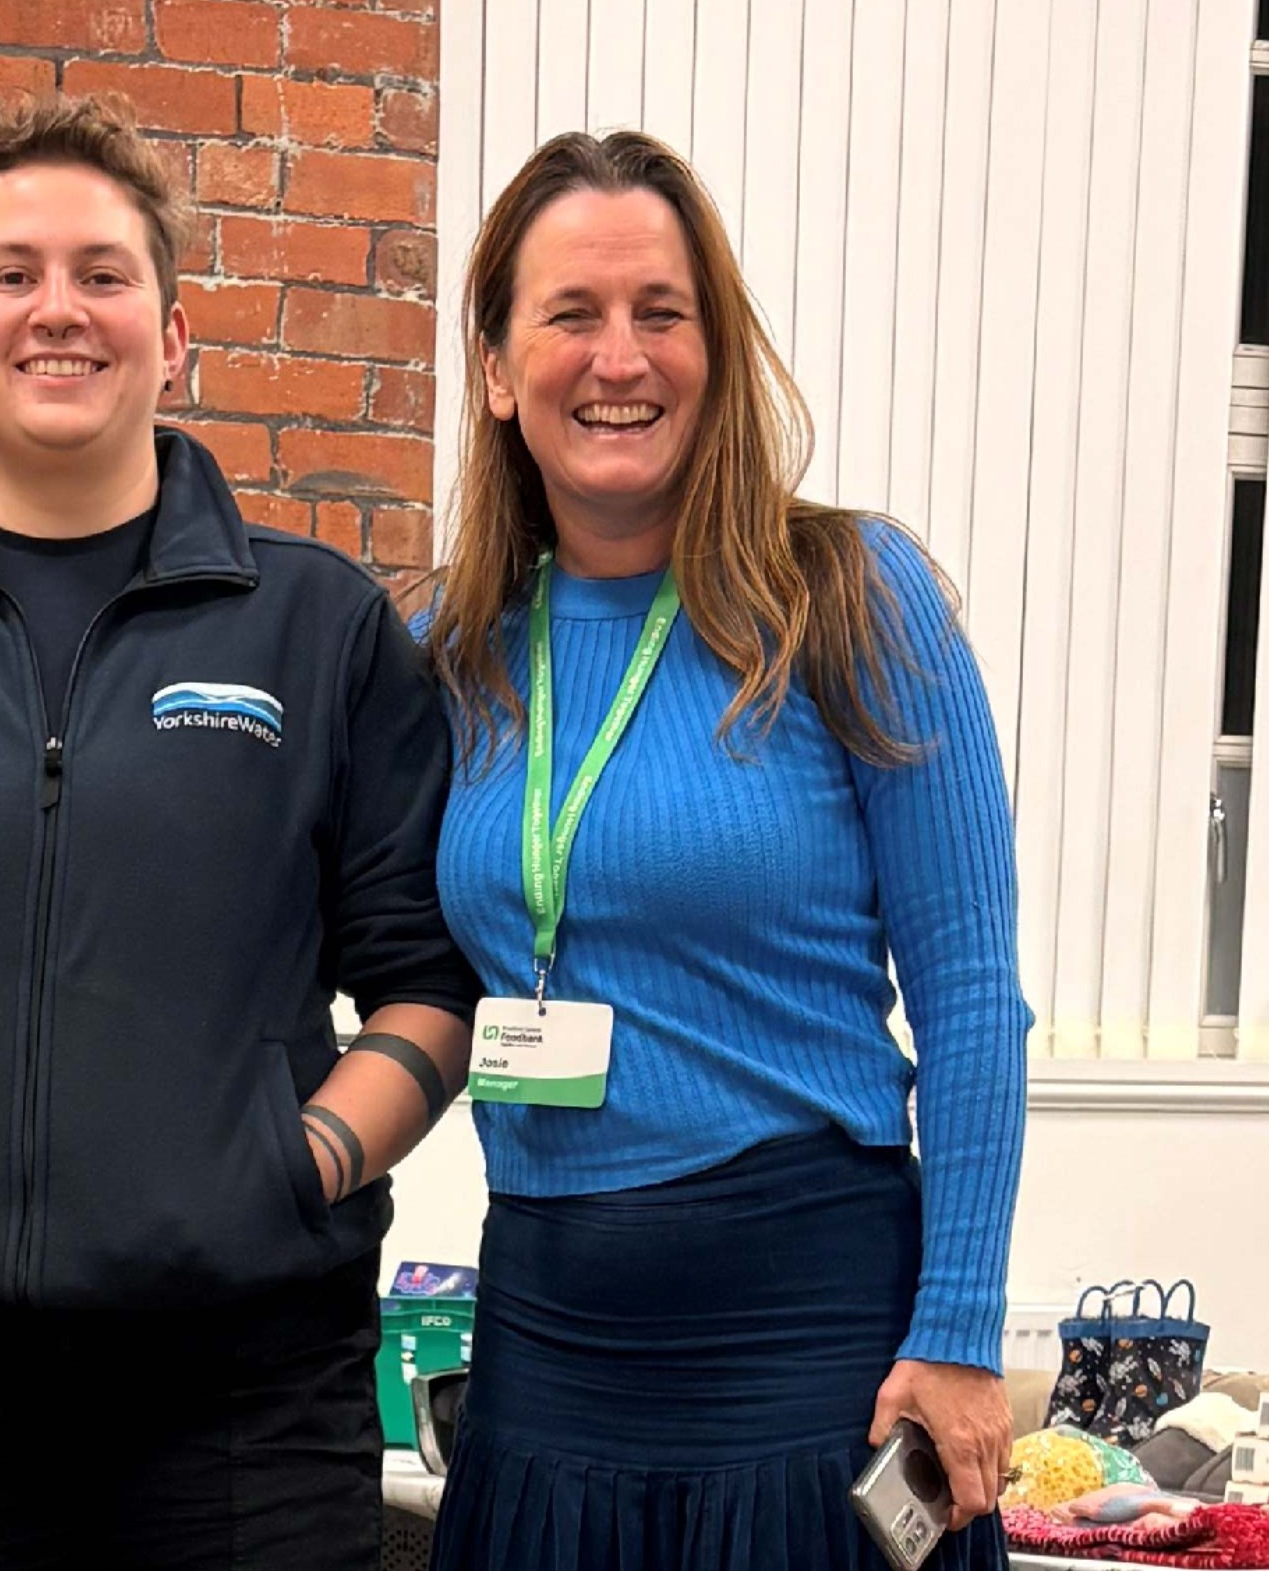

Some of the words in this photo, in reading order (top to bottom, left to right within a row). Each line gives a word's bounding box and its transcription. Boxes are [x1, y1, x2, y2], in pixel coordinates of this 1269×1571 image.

[500, 1032, 543, 1043] Foodbank
[479, 1057, 509, 1069] Josie
[477, 1078, 519, 1091] Manager
